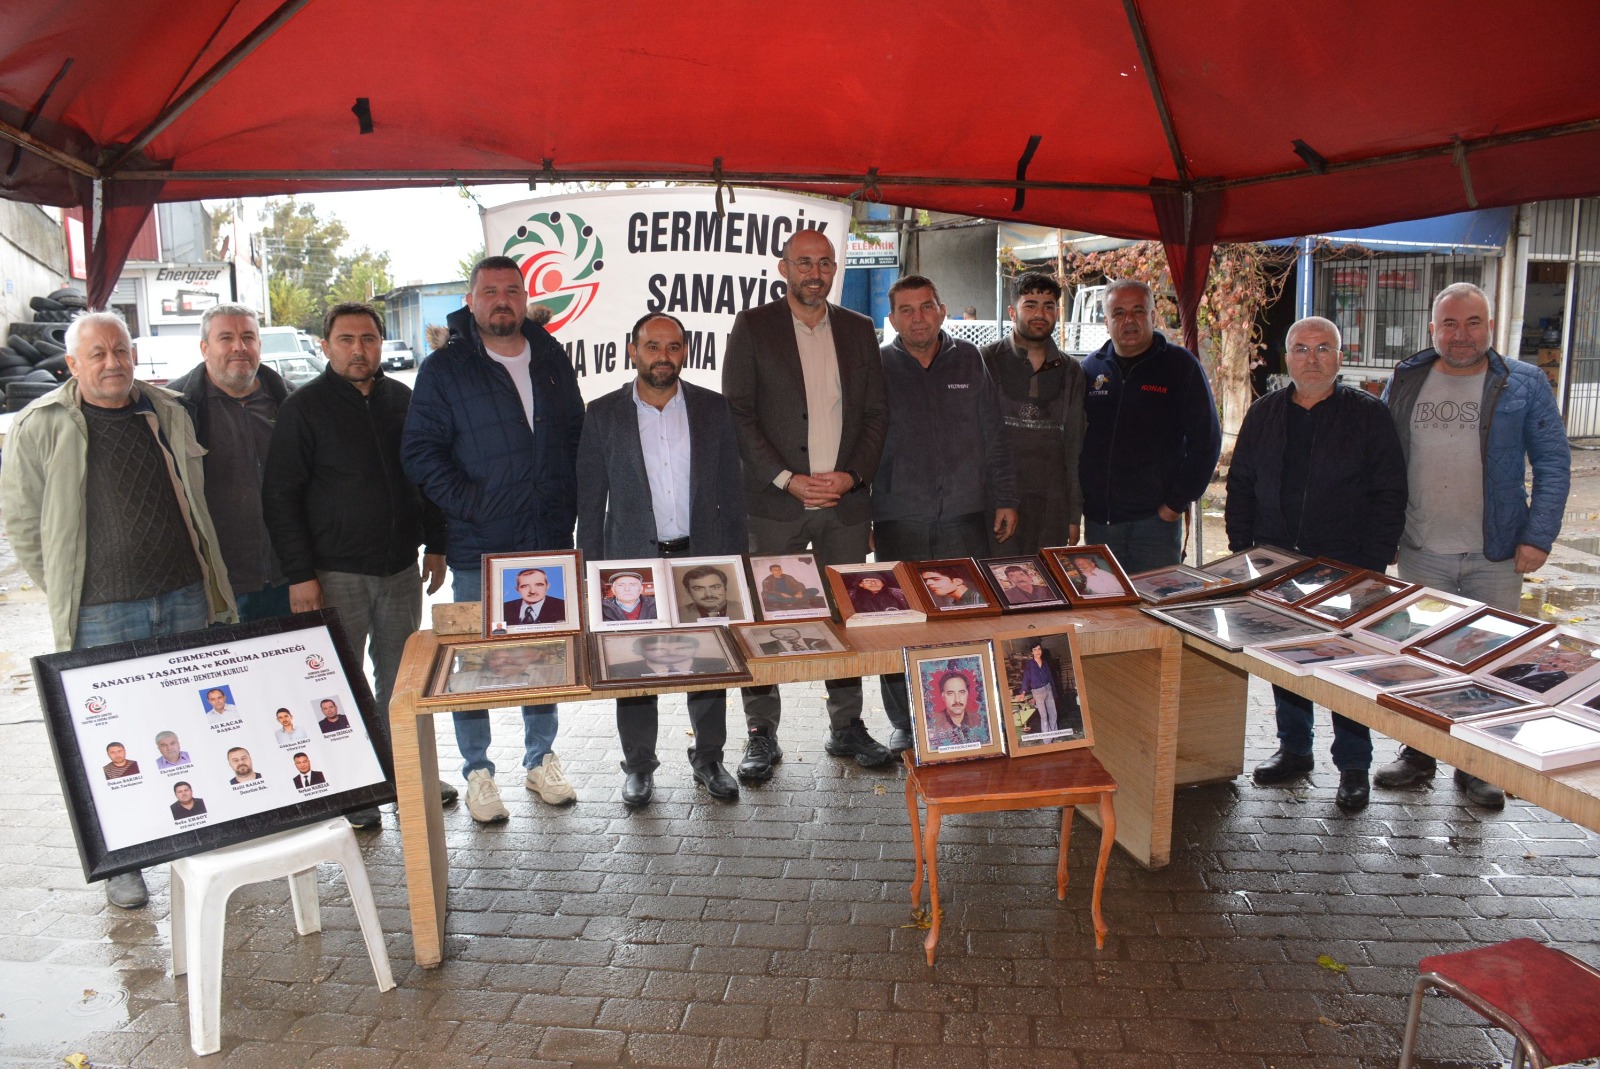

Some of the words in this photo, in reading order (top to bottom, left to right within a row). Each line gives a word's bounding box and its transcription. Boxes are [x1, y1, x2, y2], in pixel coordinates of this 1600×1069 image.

[859, 257, 875, 265] AKÜ
[156, 267, 221, 284] Energizer
[594, 341, 616, 374] ve
[1141, 384, 1168, 394] KONAR
[1414, 401, 1480, 423] BOS
[168, 648, 231, 665] GERMENCİK
[92, 674, 146, 690] SANAYİSİ
[147, 664, 200, 680] YAŞATMA
[201, 662, 213, 670] ve
[214, 653, 260, 667] KORUMA
[261, 644, 306, 658] DERNEĞİ
[160, 676, 190, 688] YÖNETİM
[193, 671, 222, 682] DENETİM
[223, 665, 249, 677] KURULU
